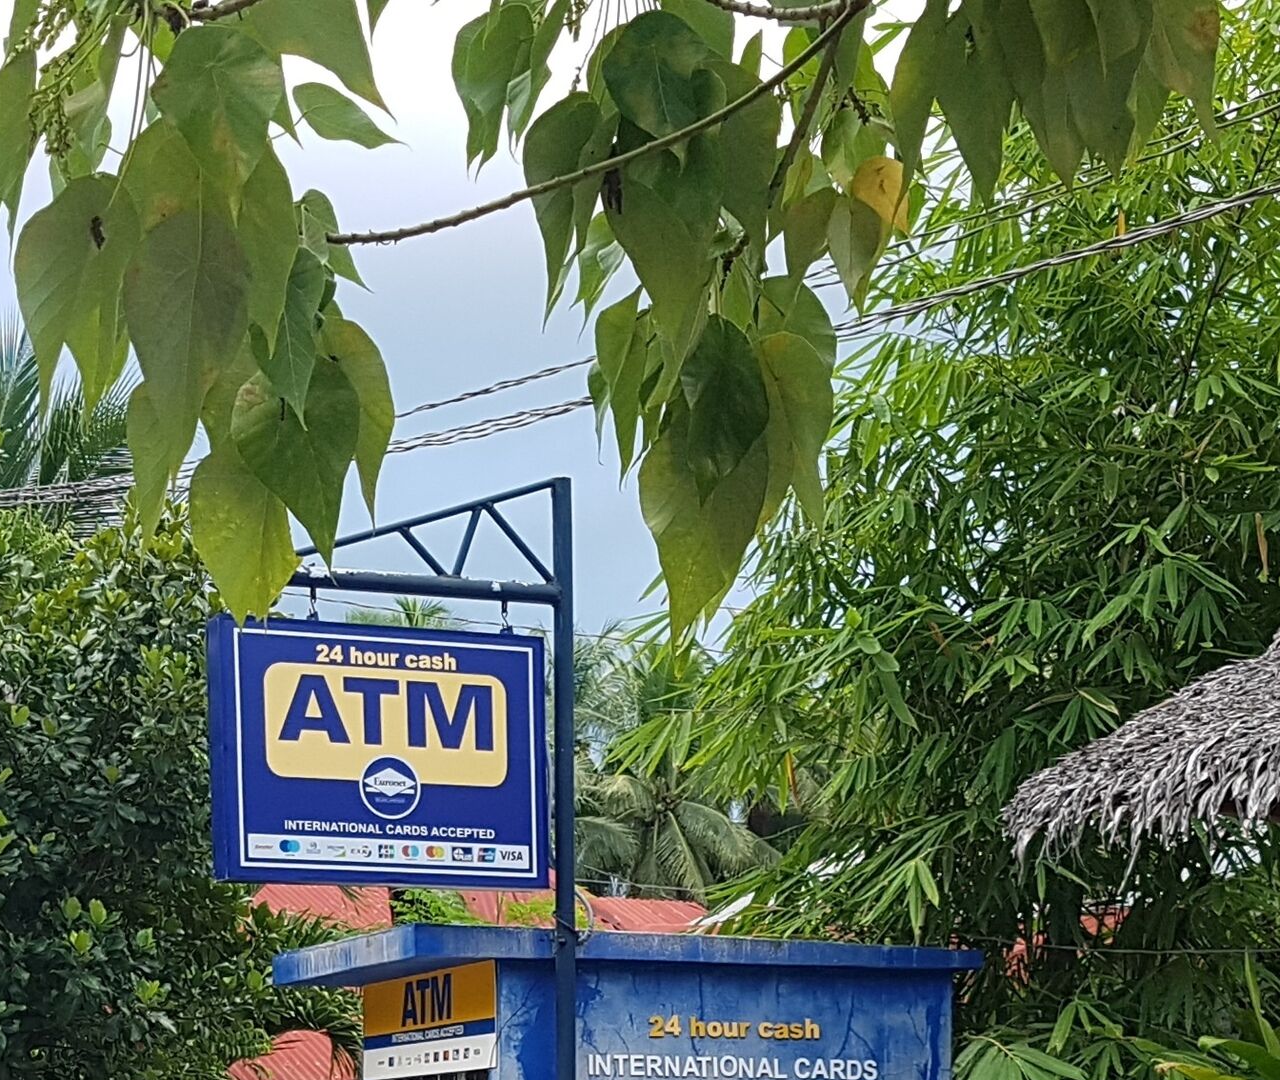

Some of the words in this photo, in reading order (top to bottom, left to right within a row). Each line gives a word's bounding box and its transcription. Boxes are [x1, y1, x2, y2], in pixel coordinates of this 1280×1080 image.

[316, 644, 343, 663] 24
[349, 646, 400, 667] hour
[404, 652, 457, 671] cash
[278, 674, 494, 752] ATM
[283, 819, 383, 834] INTERNATIONAL
[385, 823, 429, 837] CARDS
[431, 826, 496, 840] ACCEPTED
[499, 850, 524, 862] VISA
[401, 973, 453, 1028] ATM
[648, 1015, 681, 1038] 24
[690, 1016, 751, 1039] hour
[758, 1018, 821, 1040] cash
[588, 1054, 788, 1080] INTERNATIONAL
[793, 1057, 879, 1080] CARDS
